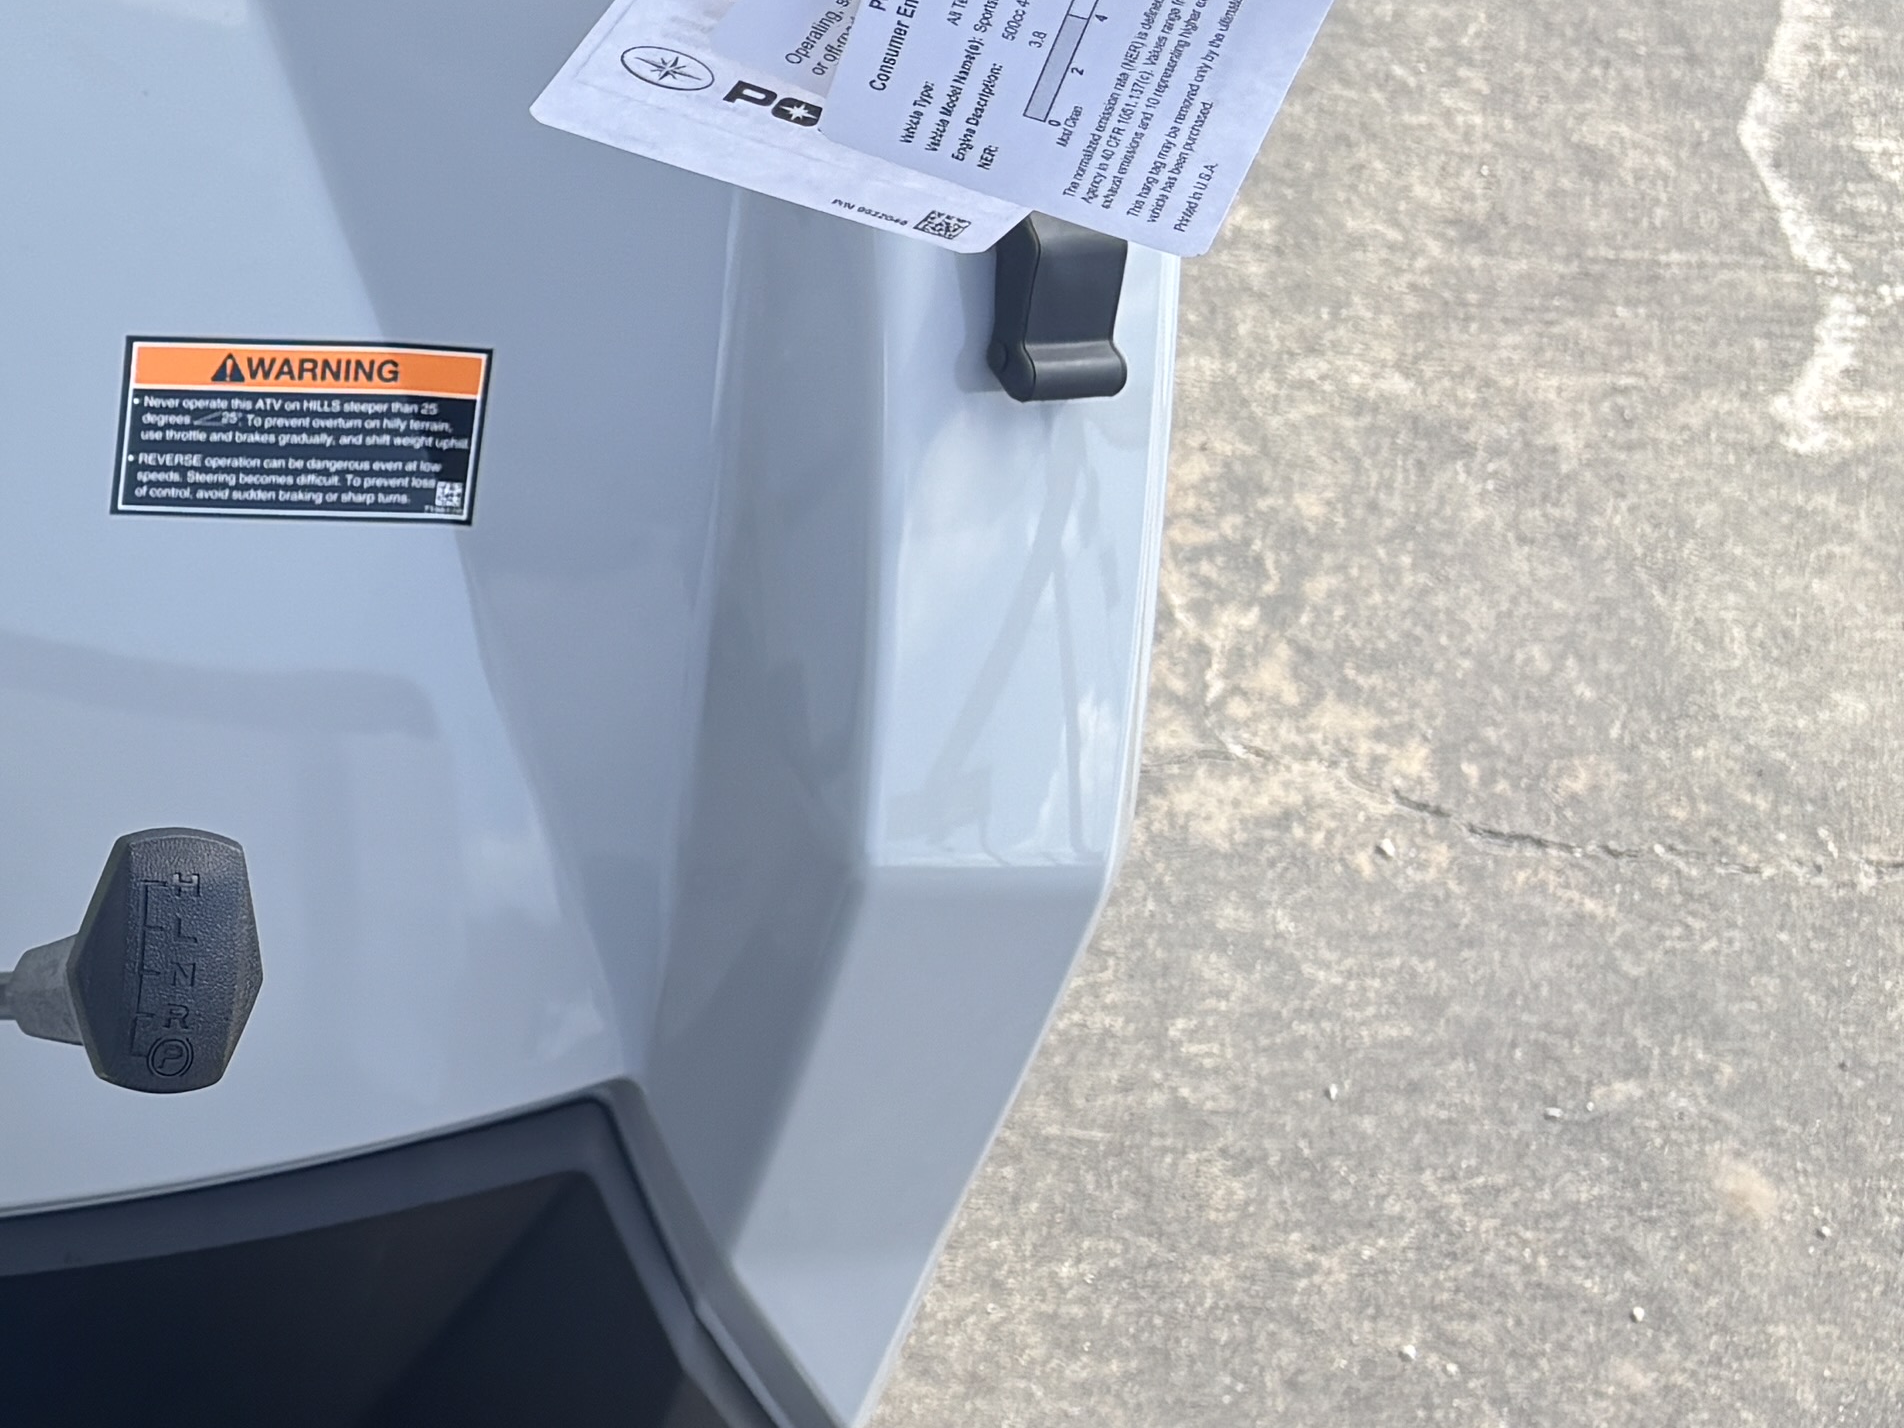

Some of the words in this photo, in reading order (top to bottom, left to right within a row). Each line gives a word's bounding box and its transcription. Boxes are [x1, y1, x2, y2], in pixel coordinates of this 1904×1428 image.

[1029, 30, 1047, 48] 3.8
[1071, 66, 1084, 76] 2
[1095, 14, 1107, 23] 4
[868, 19, 910, 91] Consumer
[247, 357, 400, 383] WARNING
[143, 395, 180, 408] Never
[182, 398, 229, 411] operate
[230, 397, 253, 411] this
[255, 397, 283, 411] ATV
[284, 401, 301, 412] on
[302, 399, 341, 413] HILLS
[343, 401, 389, 415] steeper
[391, 401, 418, 414] than
[420, 402, 437, 415] 25
[173, 872, 202, 899] H
[164, 1005, 189, 1029] R
